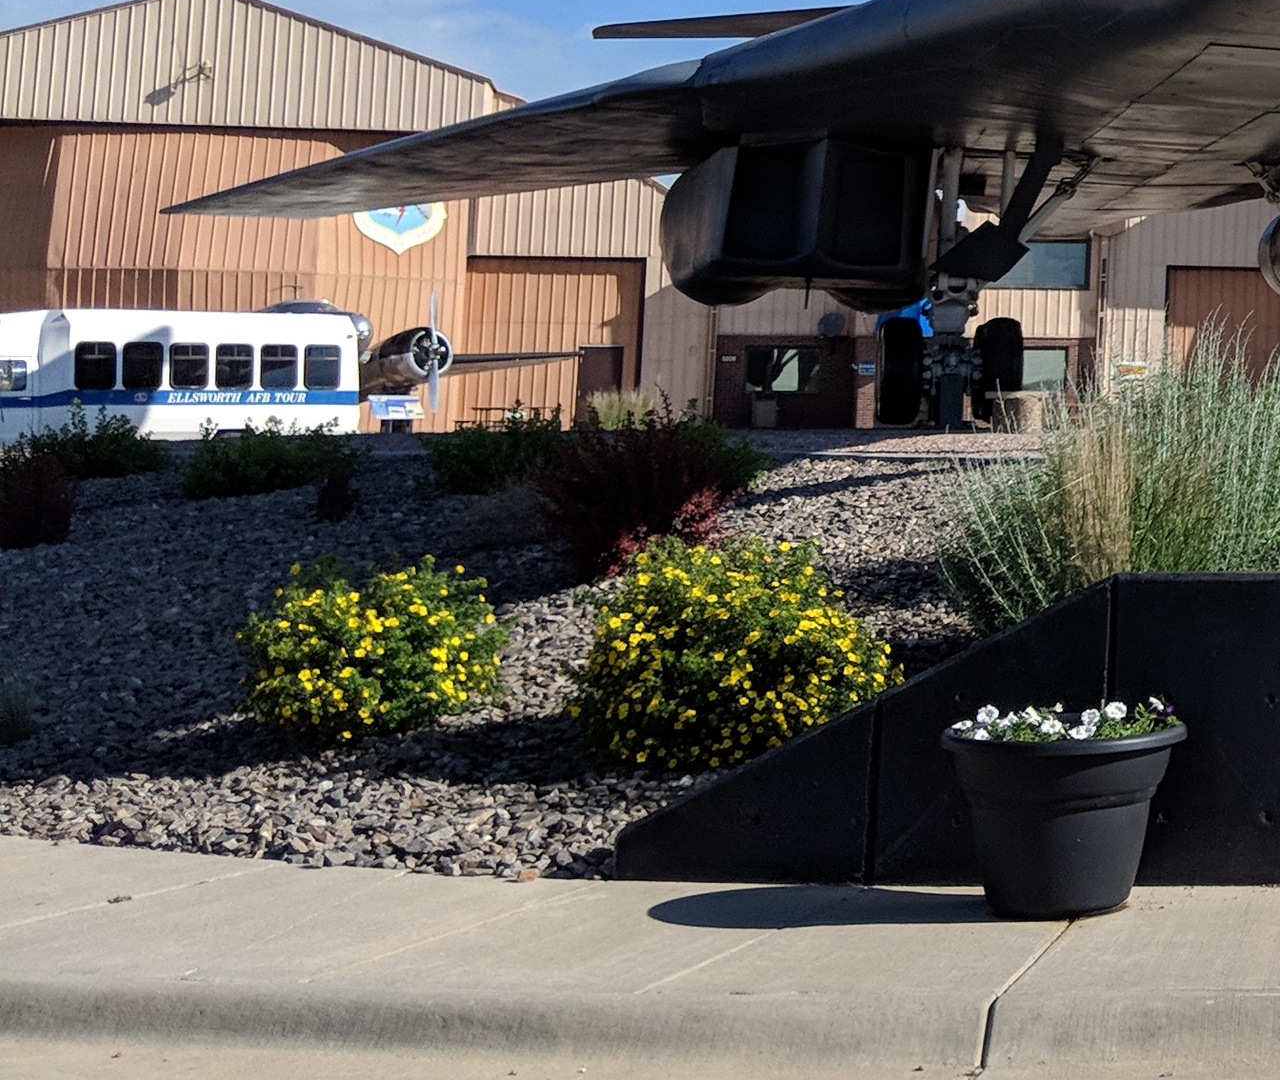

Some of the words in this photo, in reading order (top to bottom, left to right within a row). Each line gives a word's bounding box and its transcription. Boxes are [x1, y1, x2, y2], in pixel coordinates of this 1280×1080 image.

[167, 392, 241, 403] ELLSWORTH
[246, 392, 271, 403] AFB
[274, 392, 306, 403] TOUR
